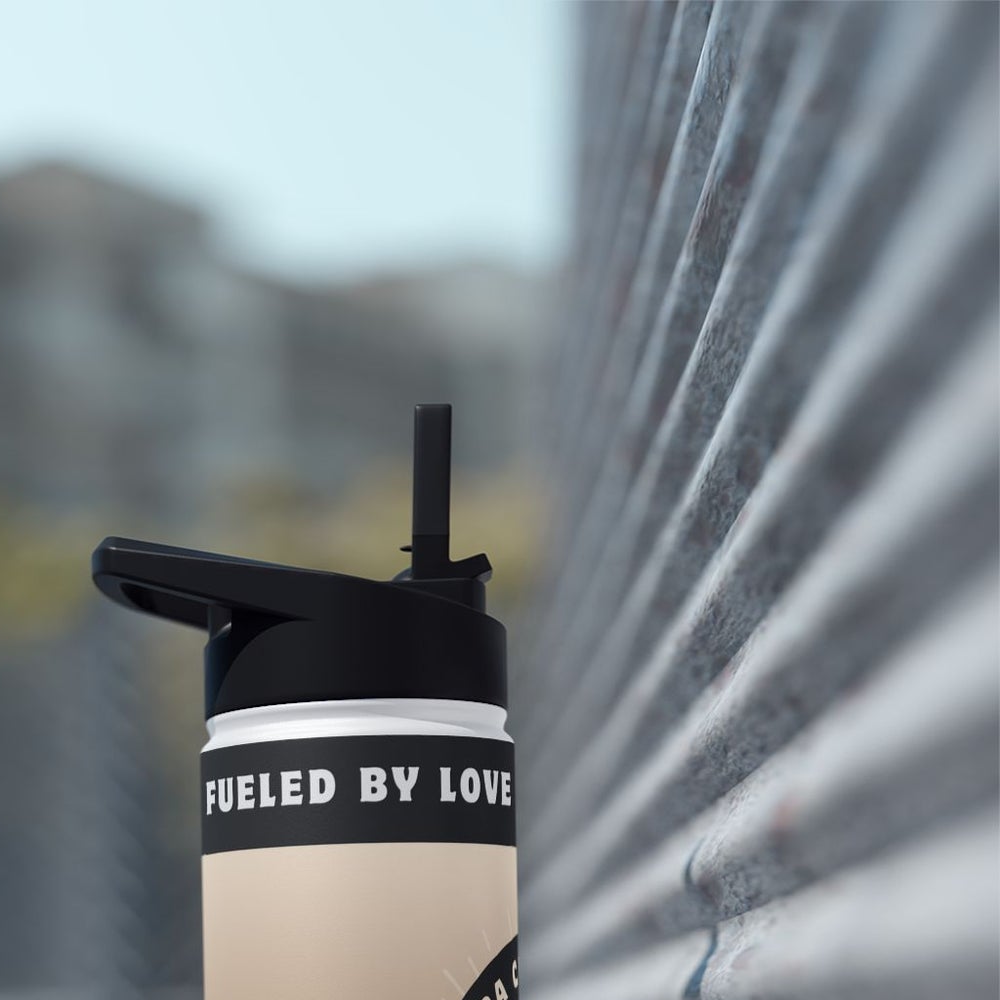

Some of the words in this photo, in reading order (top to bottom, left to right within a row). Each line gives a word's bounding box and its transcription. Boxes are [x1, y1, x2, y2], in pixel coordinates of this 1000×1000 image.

[206, 768, 336, 816] FUELED
[359, 766, 420, 803] BY
[439, 766, 512, 807] LOVE
